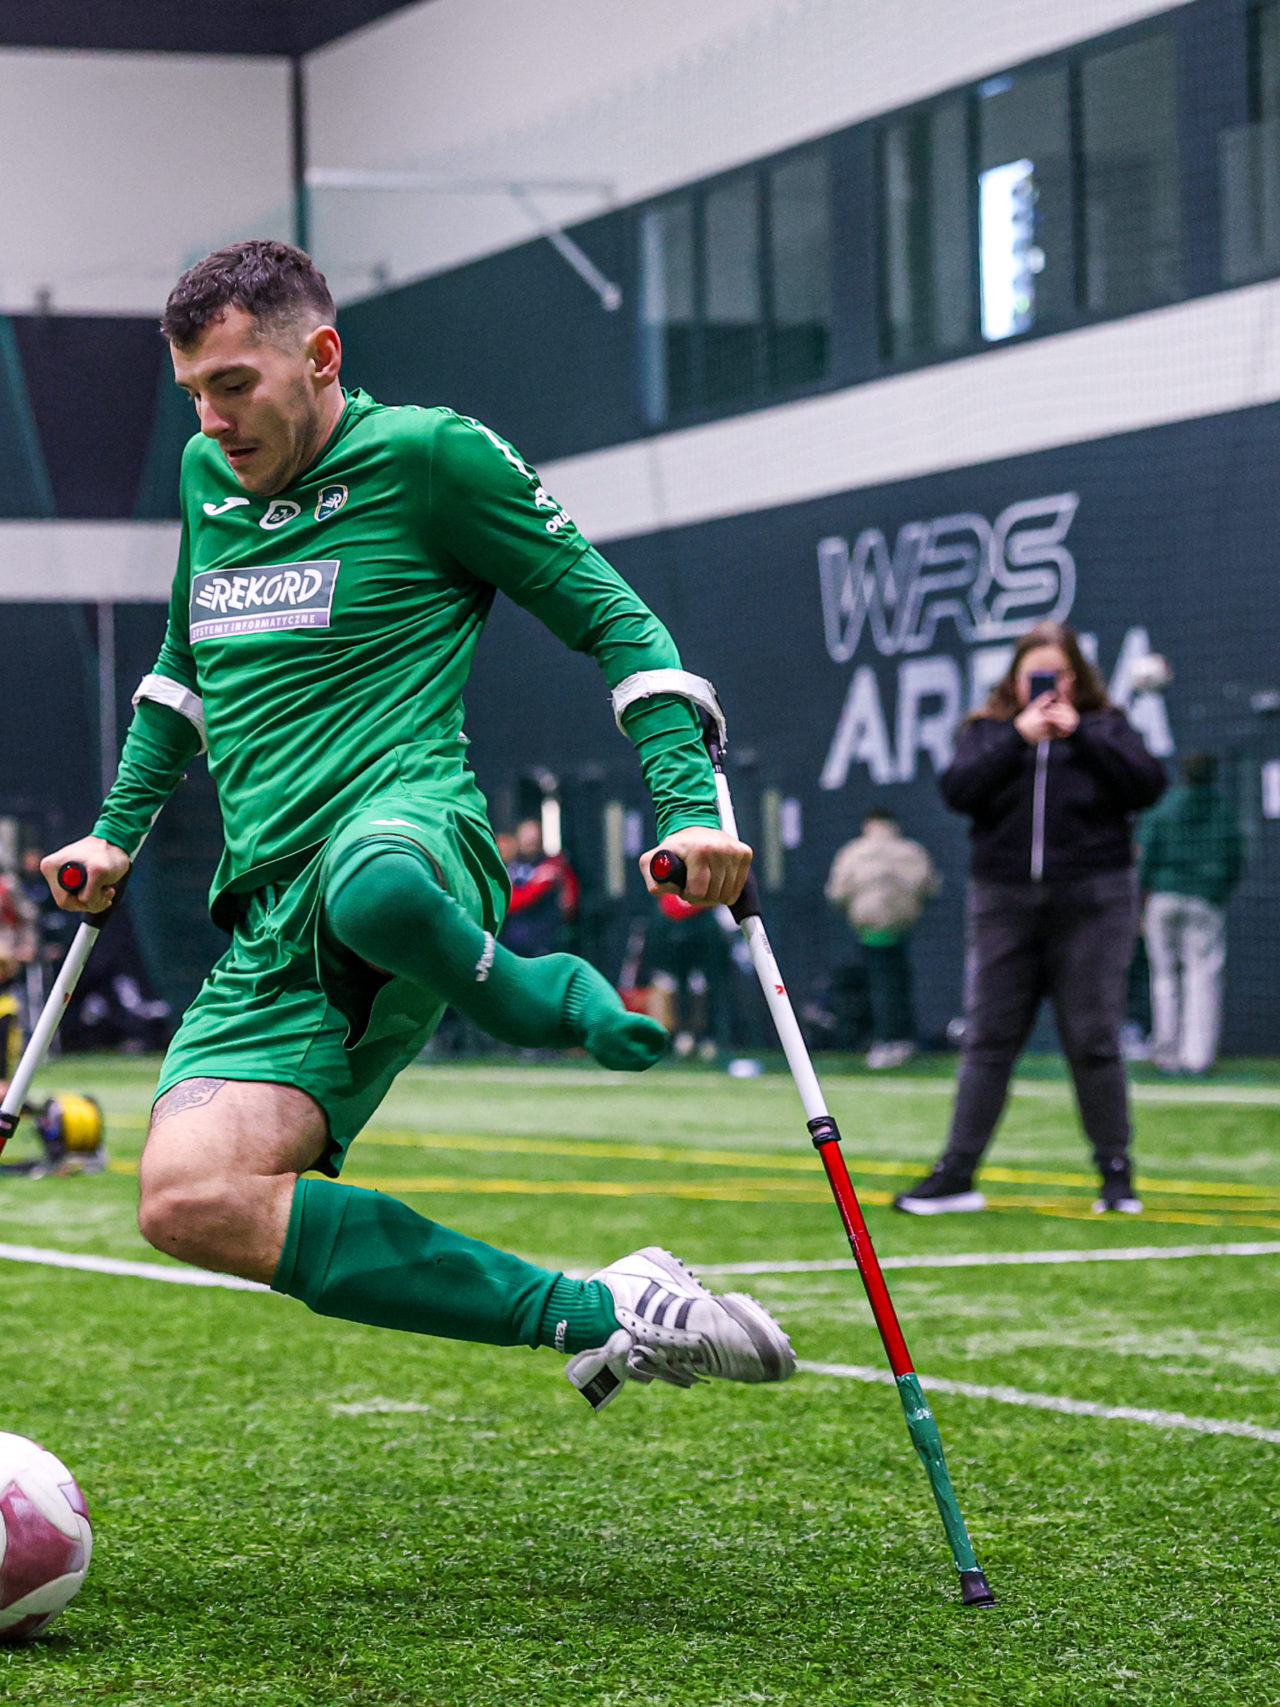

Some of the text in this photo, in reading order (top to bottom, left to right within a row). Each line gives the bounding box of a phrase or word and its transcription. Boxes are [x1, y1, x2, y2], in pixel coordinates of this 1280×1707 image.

[203, 569, 323, 613] REKORD
[817, 491, 1080, 663] WRS
[231, 614, 316, 632] INFORMATYCZNE
